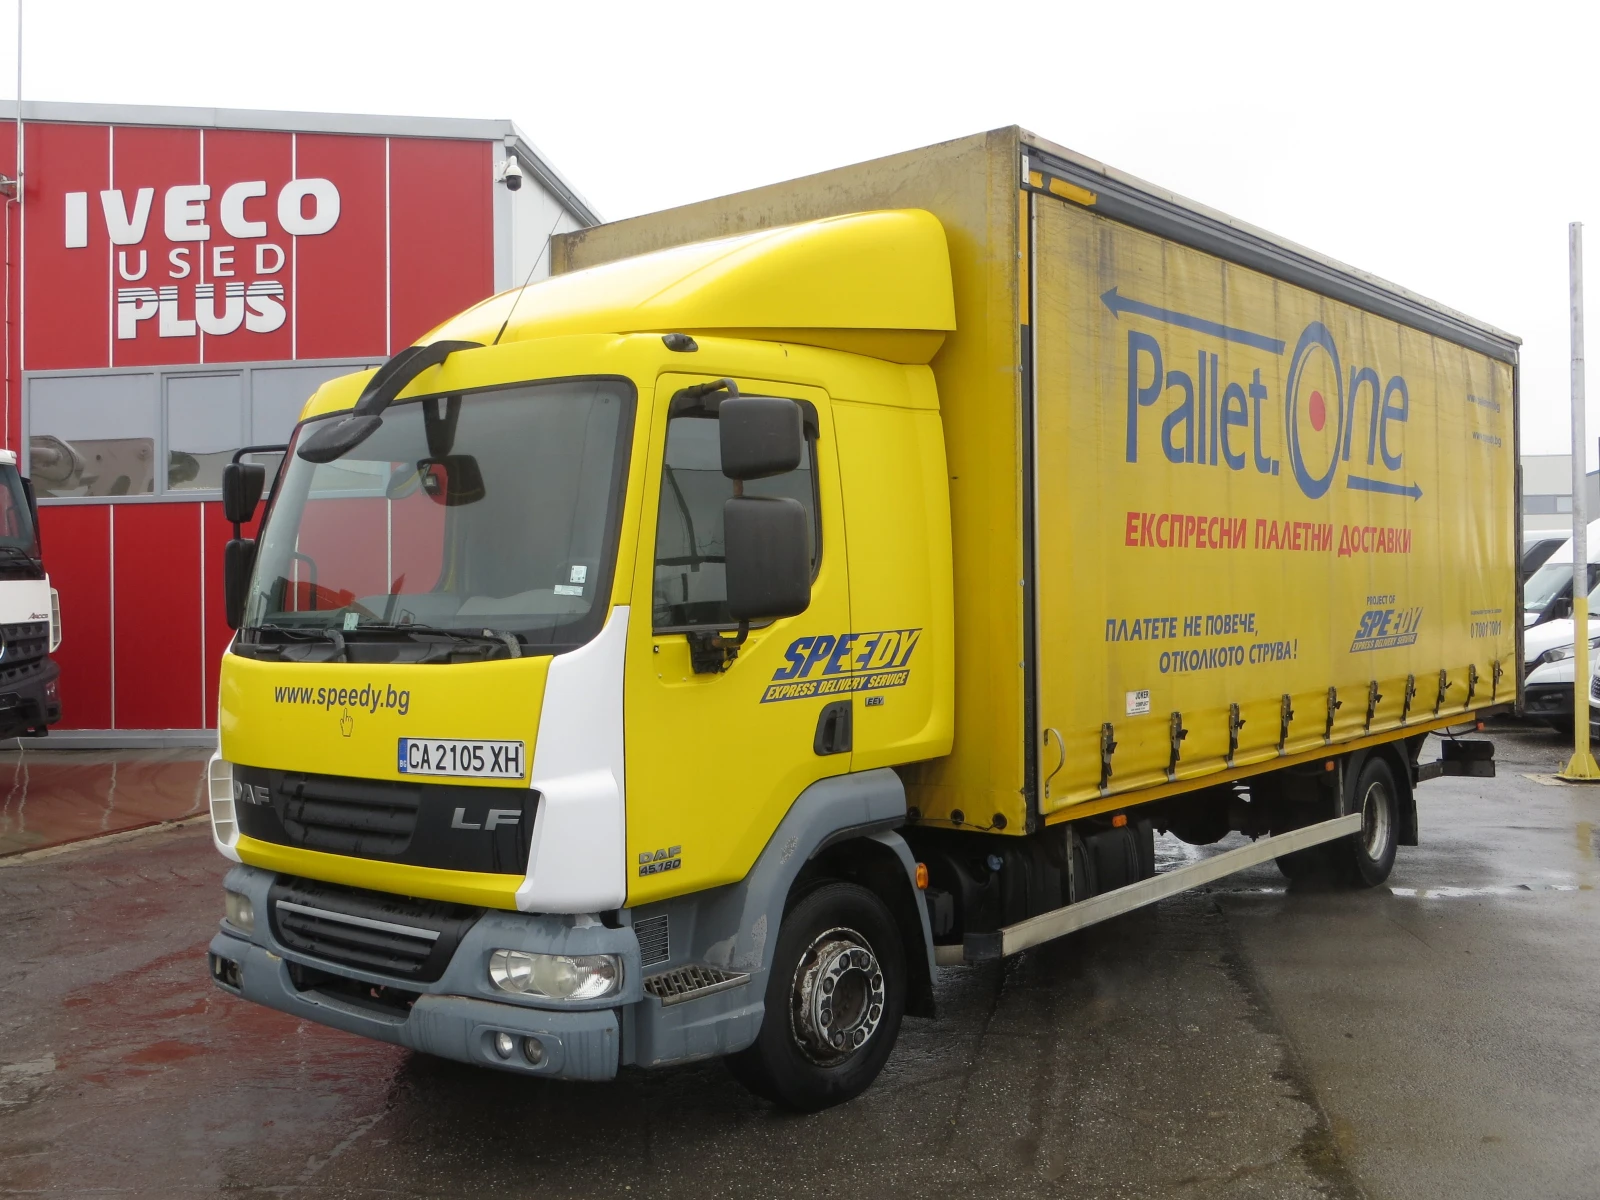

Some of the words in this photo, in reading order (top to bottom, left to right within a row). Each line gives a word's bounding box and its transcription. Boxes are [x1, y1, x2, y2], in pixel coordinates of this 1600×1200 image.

[65, 177, 341, 249] IVECO
[118, 243, 286, 282] USED
[117, 280, 287, 340] PLUS
[1125, 511, 1247, 549] ЕКСПРЕСНИ
[1254, 518, 1333, 552] ПАЛЕТНИ
[1337, 524, 1412, 558] ДОСТАВКИ
[1366, 595, 1388, 606] PROJECT
[1388, 594, 1396, 604] OF
[1105, 616, 1178, 642] ПЛАТЕТЕ
[1183, 615, 1202, 637] НЕ
[1205, 612, 1259, 637] ПОВЕЧЕ,
[1354, 606, 1424, 640] SPEEDY
[771, 627, 923, 682] SPEEDY
[1351, 639, 1375, 652] EXPRESS
[1374, 637, 1397, 649] DELIVERY
[1396, 634, 1416, 646] SERVICE
[1159, 649, 1245, 674] ОТКОЛКОТО
[274, 682, 411, 716] www.speedy.bg
[764, 681, 816, 702] EXPRESS
[817, 676, 868, 696] DELIVERY
[867, 671, 909, 689] SERVICE
[1135, 690, 1149, 700] JOKER
[867, 697, 883, 706] EEV
[399, 759, 407, 768] BG
[408, 743, 431, 771] CA
[435, 744, 485, 773] 2105
[490, 745, 520, 774] XH
[233, 779, 270, 806] DAF
[450, 807, 522, 831] LF
[639, 845, 682, 865] DAF
[639, 858, 682, 877] 45.180
